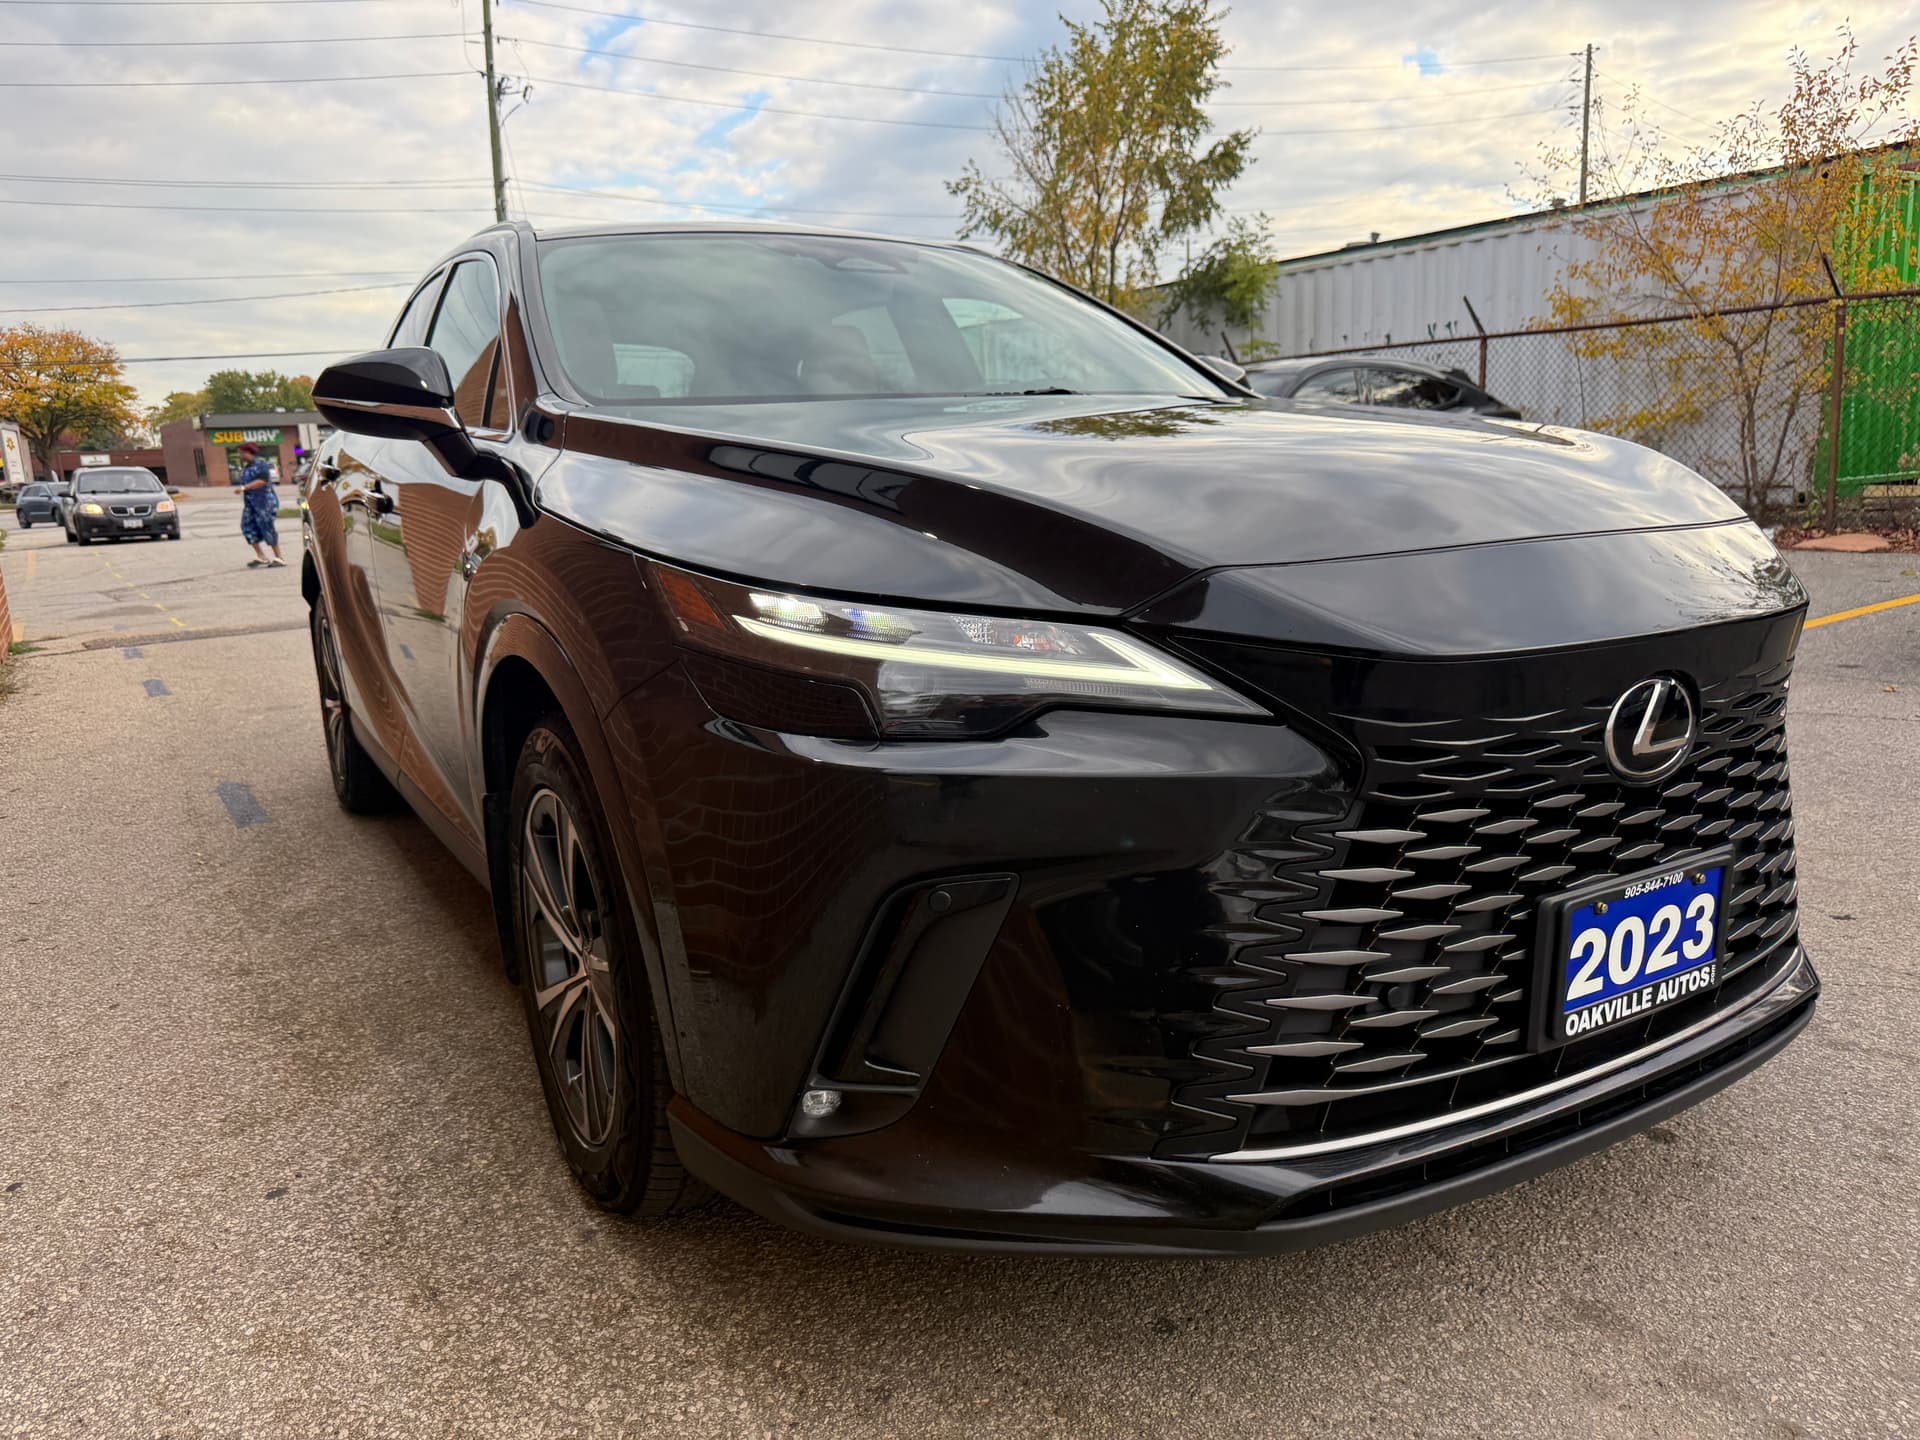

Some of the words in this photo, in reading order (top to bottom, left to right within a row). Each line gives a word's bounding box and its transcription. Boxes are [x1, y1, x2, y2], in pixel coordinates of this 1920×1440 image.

[213, 429, 280, 443] SUBWAY
[1624, 871, 1684, 899] 905-844-7100
[1566, 893, 1716, 1001] 2023
[1565, 987, 1653, 1037] OAKVILLE
[1656, 966, 1711, 1005] AUTOS
